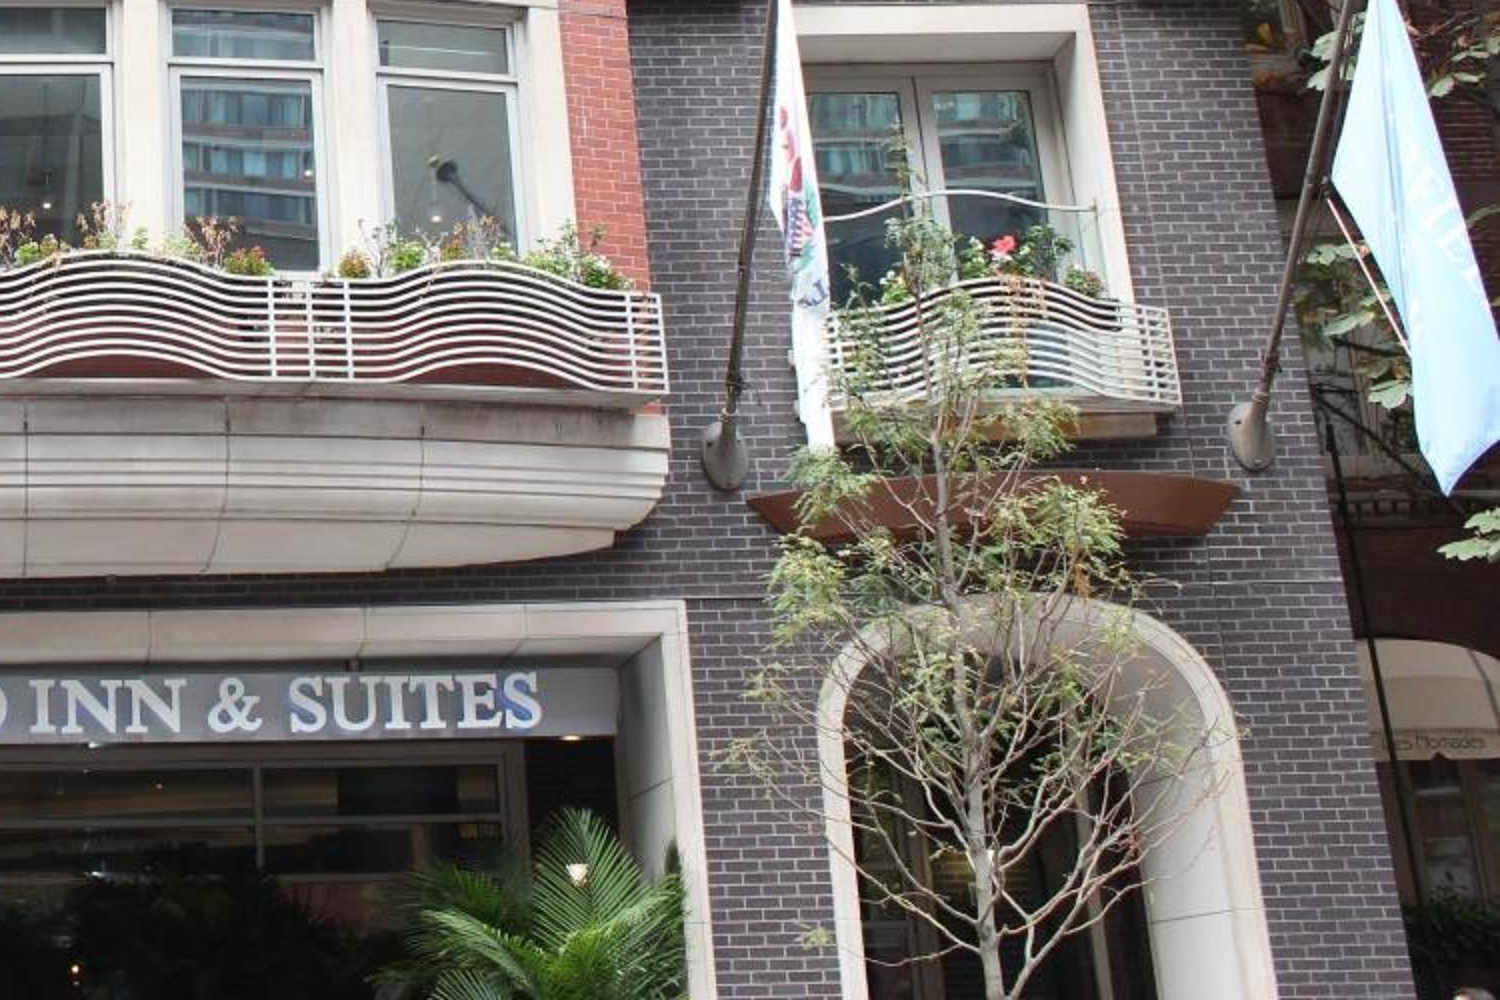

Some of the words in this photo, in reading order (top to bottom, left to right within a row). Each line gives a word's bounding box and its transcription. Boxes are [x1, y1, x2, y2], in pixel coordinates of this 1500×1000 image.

[29, 679, 187, 735] INN
[207, 677, 264, 734] &
[289, 672, 544, 735] SUITES
